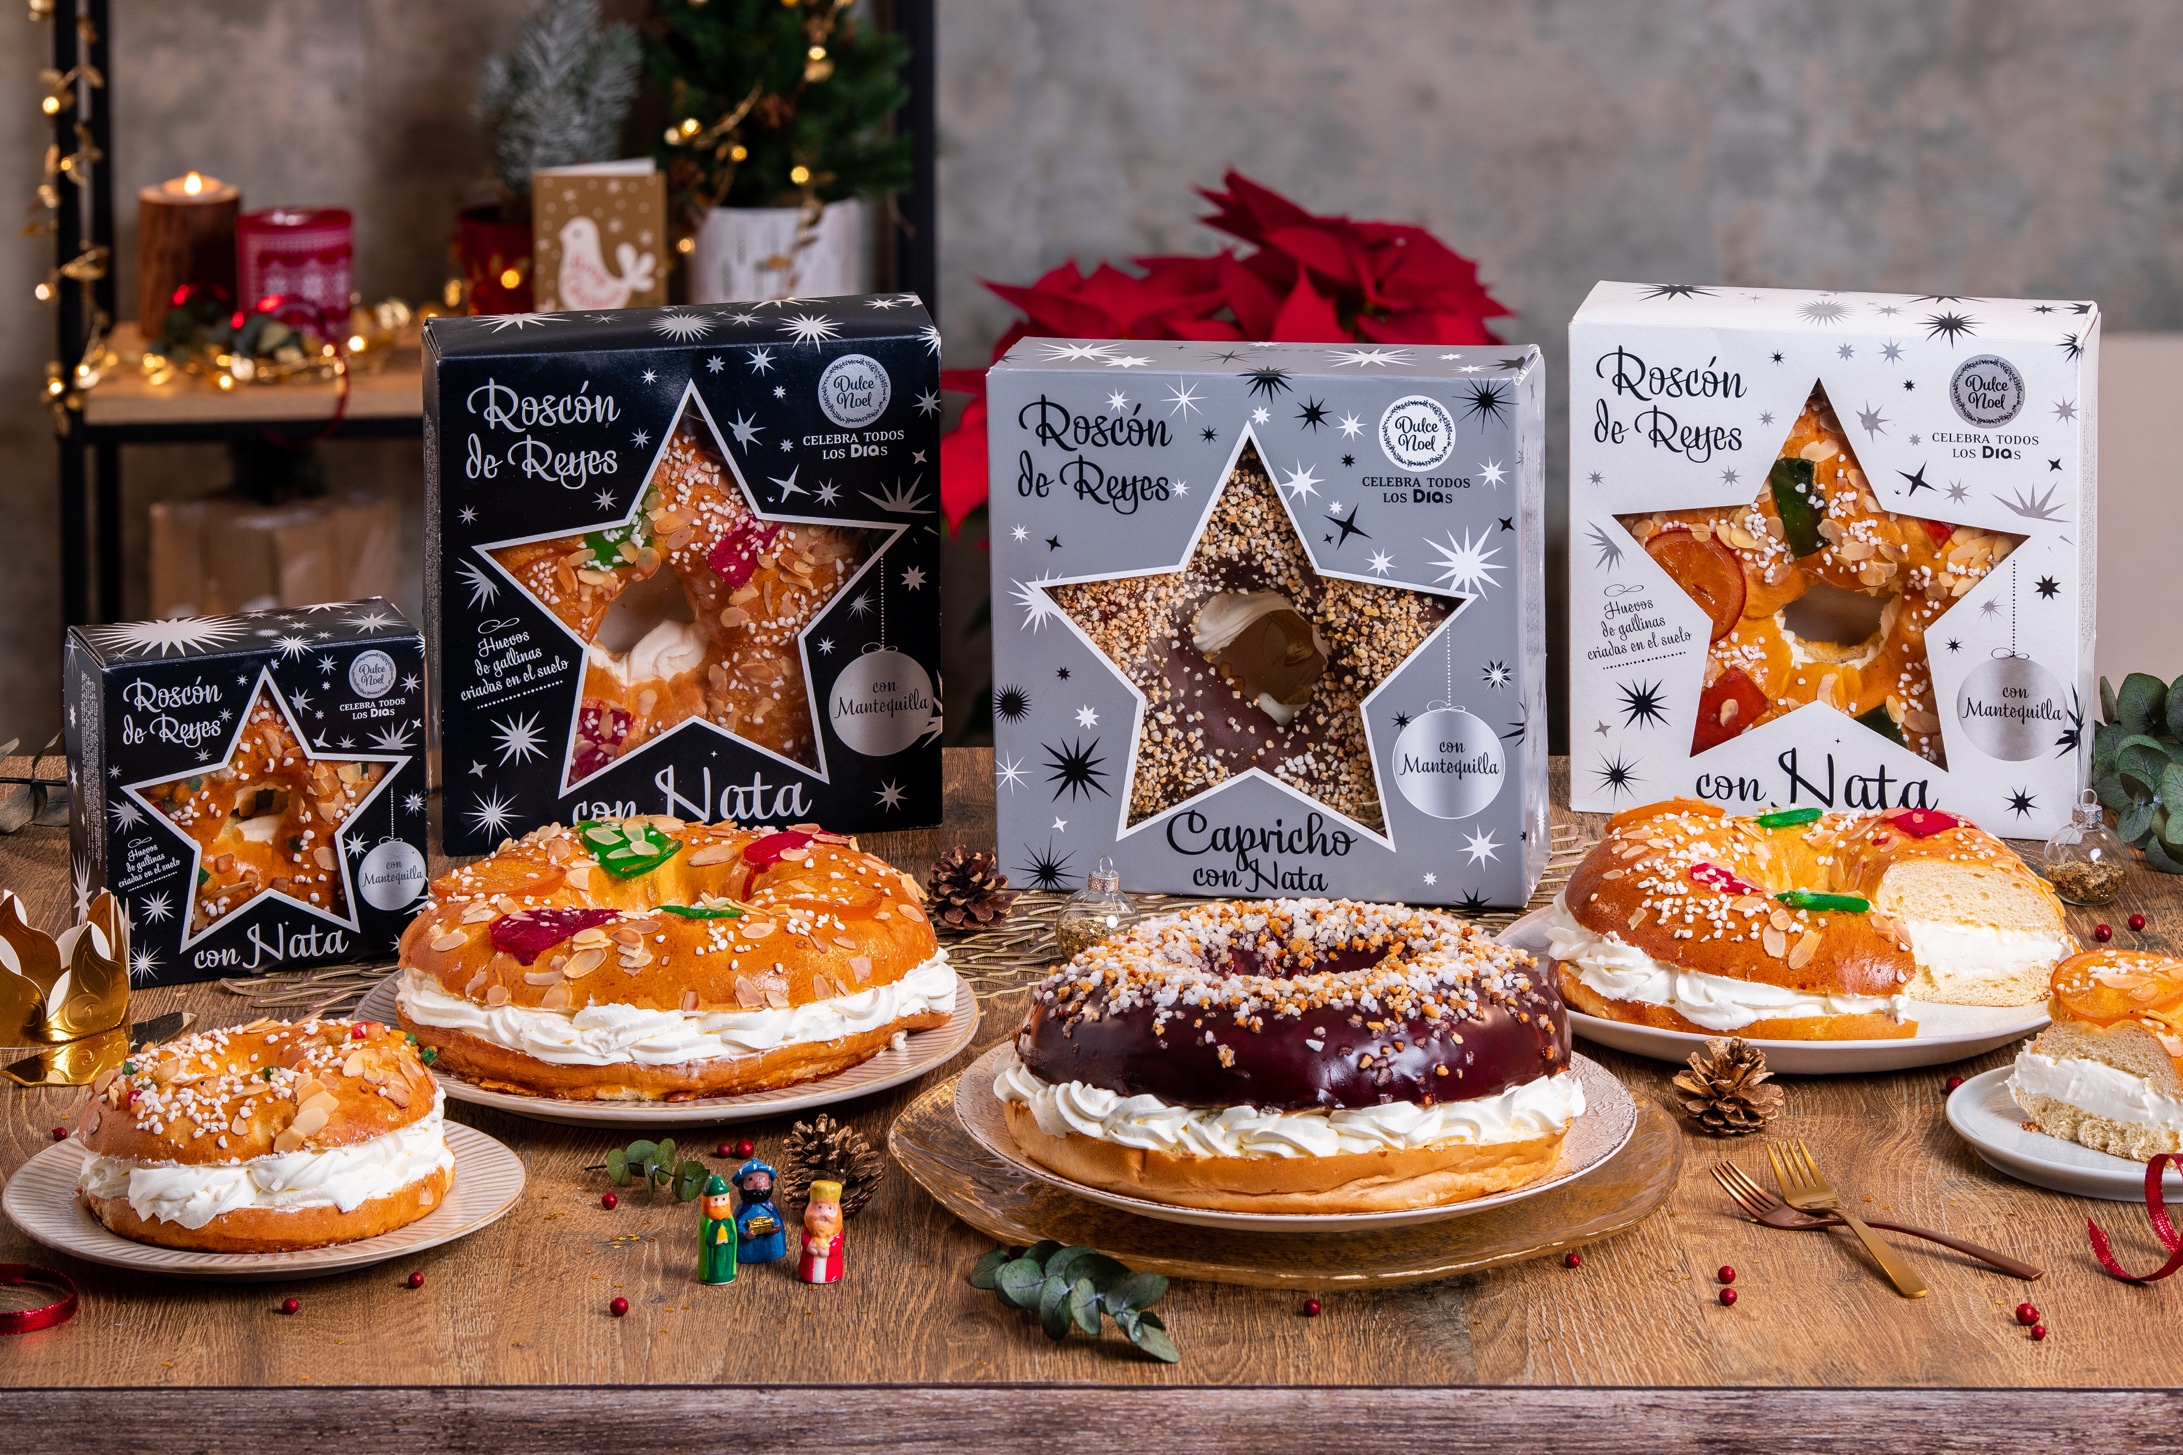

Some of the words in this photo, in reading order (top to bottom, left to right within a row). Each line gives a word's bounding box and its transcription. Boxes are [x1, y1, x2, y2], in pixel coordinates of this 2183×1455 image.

[833, 374, 876, 393] Dulce
[1595, 344, 1749, 402] Roscón
[1964, 374, 2010, 393] Dulce
[465, 377, 621, 434] Roscón
[837, 392, 872, 409] Noel
[1968, 392, 2005, 410] Noel
[1017, 393, 1174, 453] Roscón
[1394, 415, 1440, 435] Dulce
[1594, 398, 1629, 444] de
[1633, 403, 1744, 464] Reyes
[802, 432, 859, 446] CELEBRA
[864, 430, 904, 442] TODOS
[1398, 434, 1435, 451] Noel
[1931, 432, 1991, 444] CELEBRA
[1995, 434, 2040, 446] TODOS
[466, 433, 501, 479] de
[508, 433, 619, 491] Reyes
[823, 449, 845, 459] LOS
[1953, 449, 1976, 458] LOS
[1018, 450, 1053, 498] de
[1058, 454, 1171, 515] Reyes
[1361, 475, 1422, 488] CELEBRA
[1426, 477, 1471, 489] TODOS
[1383, 493, 1407, 503] LOS
[1603, 599, 1654, 621] Huevos
[1601, 621, 1616, 637] de
[1618, 613, 1666, 642] gallinas
[477, 631, 530, 658] Huevos
[1588, 641, 1627, 660] criadas
[1631, 642, 1645, 652] en
[1648, 632, 1659, 648] el
[1661, 626, 1692, 646] suelo
[359, 664, 386, 675] Dulce
[475, 659, 490, 676] de
[492, 646, 543, 678] gallinas
[361, 674, 384, 686] Noel
[460, 678, 503, 701] criadas
[506, 676, 521, 687] en
[523, 664, 536, 682] el
[537, 655, 569, 677] suelo
[872, 680, 898, 694] con
[122, 675, 223, 714] Roscón
[2003, 685, 2029, 699] con
[340, 701, 376, 711] CELEBRA
[379, 698, 406, 707] TODOS
[352, 712, 367, 720] LOS
[833, 691, 931, 721] Mantequilla
[1962, 696, 2064, 725] Mantequilla
[123, 716, 147, 745] de
[148, 715, 222, 749] Reyes
[1439, 739, 1466, 754] con
[1398, 749, 1500, 781] Mantequilla
[1695, 772, 1767, 803] con
[1770, 746, 1940, 812] Nata
[572, 800, 644, 827] con
[654, 764, 813, 824] Nata
[1166, 809, 1359, 872] Capricho
[126, 862, 135, 872] de
[137, 854, 165, 873] gallinas
[128, 844, 158, 861] Huevos
[118, 873, 142, 887] criadas
[154, 863, 161, 874] el
[162, 857, 180, 871] suelo
[361, 864, 424, 888] Mantequilla
[386, 861, 402, 870] con
[1192, 867, 1243, 888] con
[1244, 857, 1329, 893] Nata
[193, 944, 241, 970] con
[242, 922, 350, 970] Nata
